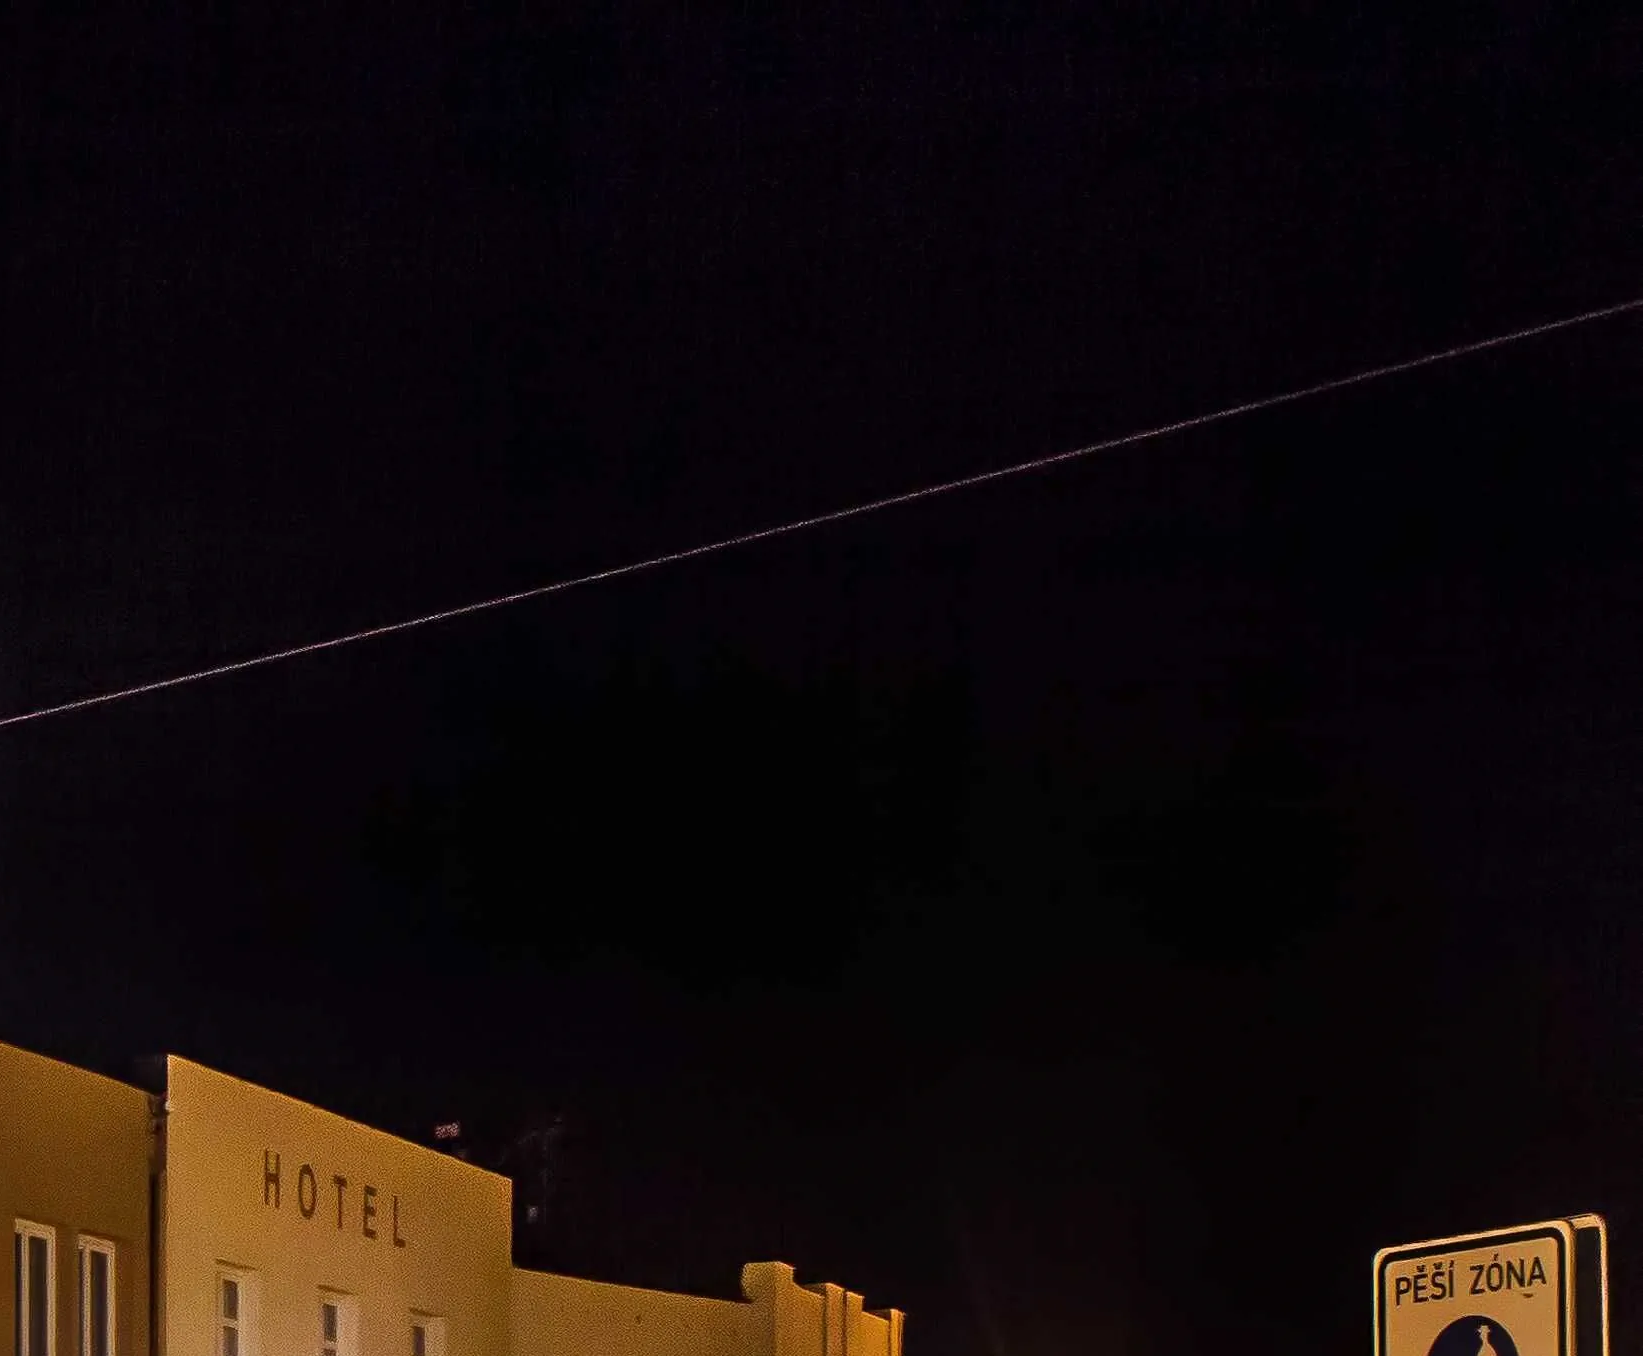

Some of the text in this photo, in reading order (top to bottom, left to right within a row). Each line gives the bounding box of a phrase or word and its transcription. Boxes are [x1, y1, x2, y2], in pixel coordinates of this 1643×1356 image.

[264, 1148, 406, 1248] HOTEL
[1395, 1253, 1547, 1306] PĚŠÍ ZÓNA
